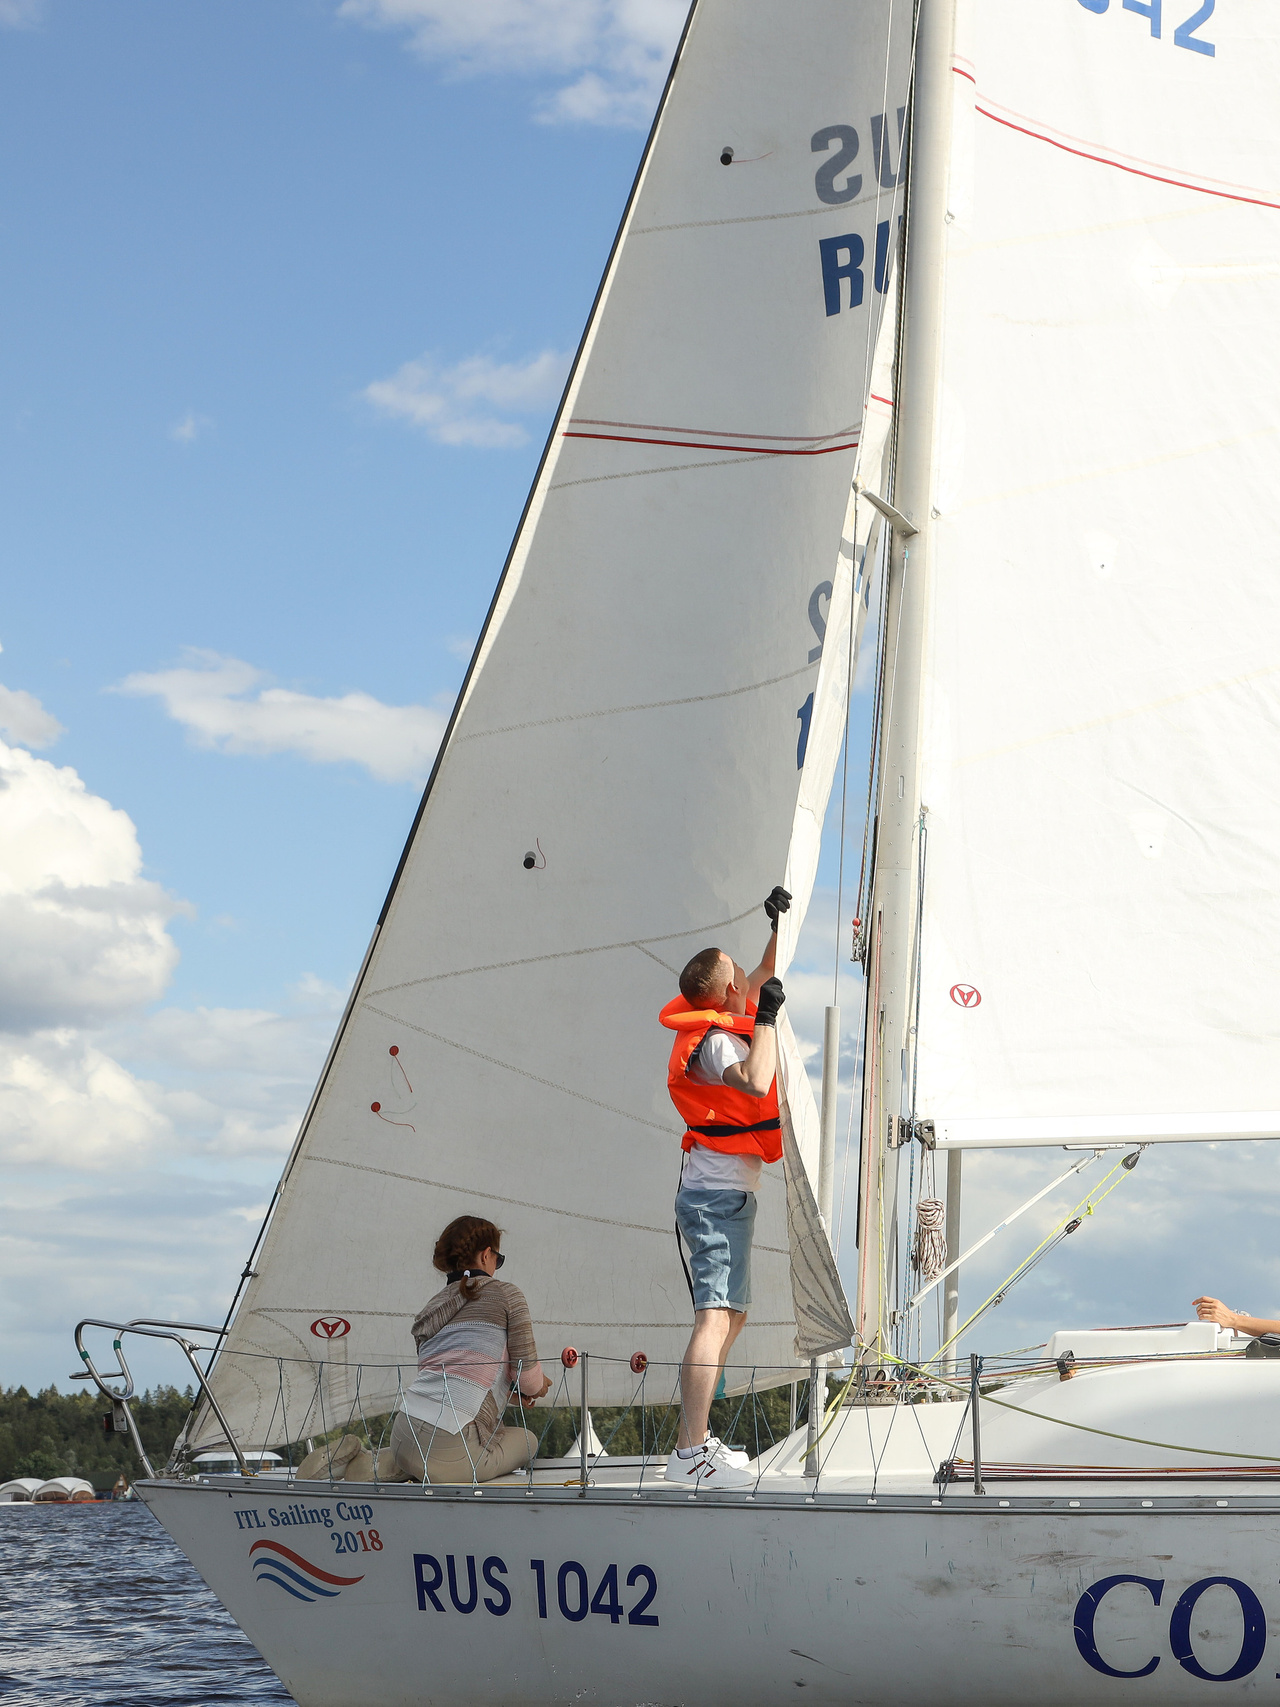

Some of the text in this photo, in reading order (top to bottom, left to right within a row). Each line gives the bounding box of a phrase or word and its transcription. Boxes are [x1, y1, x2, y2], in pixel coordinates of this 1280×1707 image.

[234, 1502, 374, 1529] ITL Sailing Cup
[331, 1529, 384, 1554] 2018
[413, 1553, 660, 1627] RUS 1042
